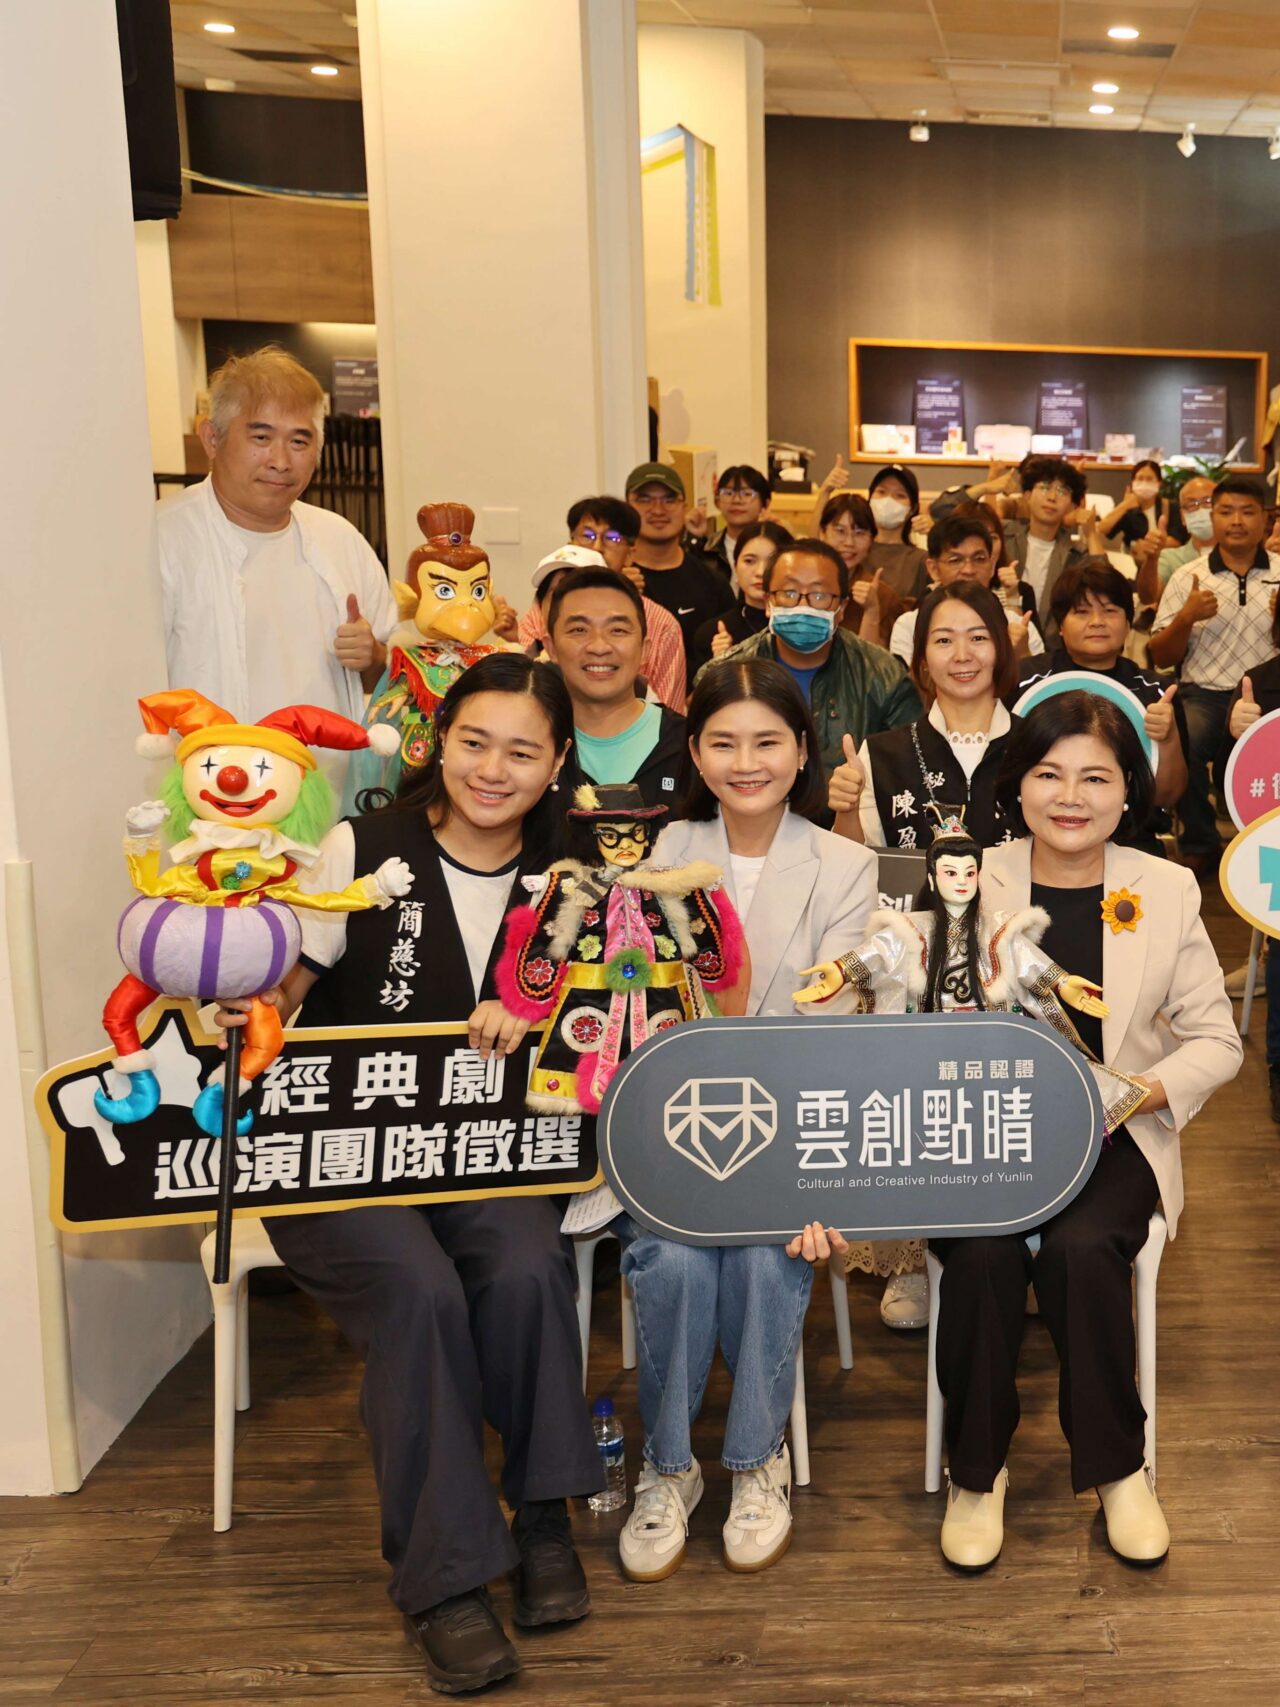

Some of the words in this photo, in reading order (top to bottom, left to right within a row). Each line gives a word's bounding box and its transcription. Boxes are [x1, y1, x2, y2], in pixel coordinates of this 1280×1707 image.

[380, 900, 426, 1012] 簡慈坊
[259, 1045, 539, 1116] 經典劇
[154, 1116, 580, 1200] 巡演團隊徵選
[797, 1177, 845, 1190] Cultural
[848, 1176, 872, 1188] and
[875, 1175, 926, 1187] Creative
[929, 1173, 979, 1187] Industry
[981, 1172, 994, 1184] of
[996, 1171, 1033, 1184] Yunlin
